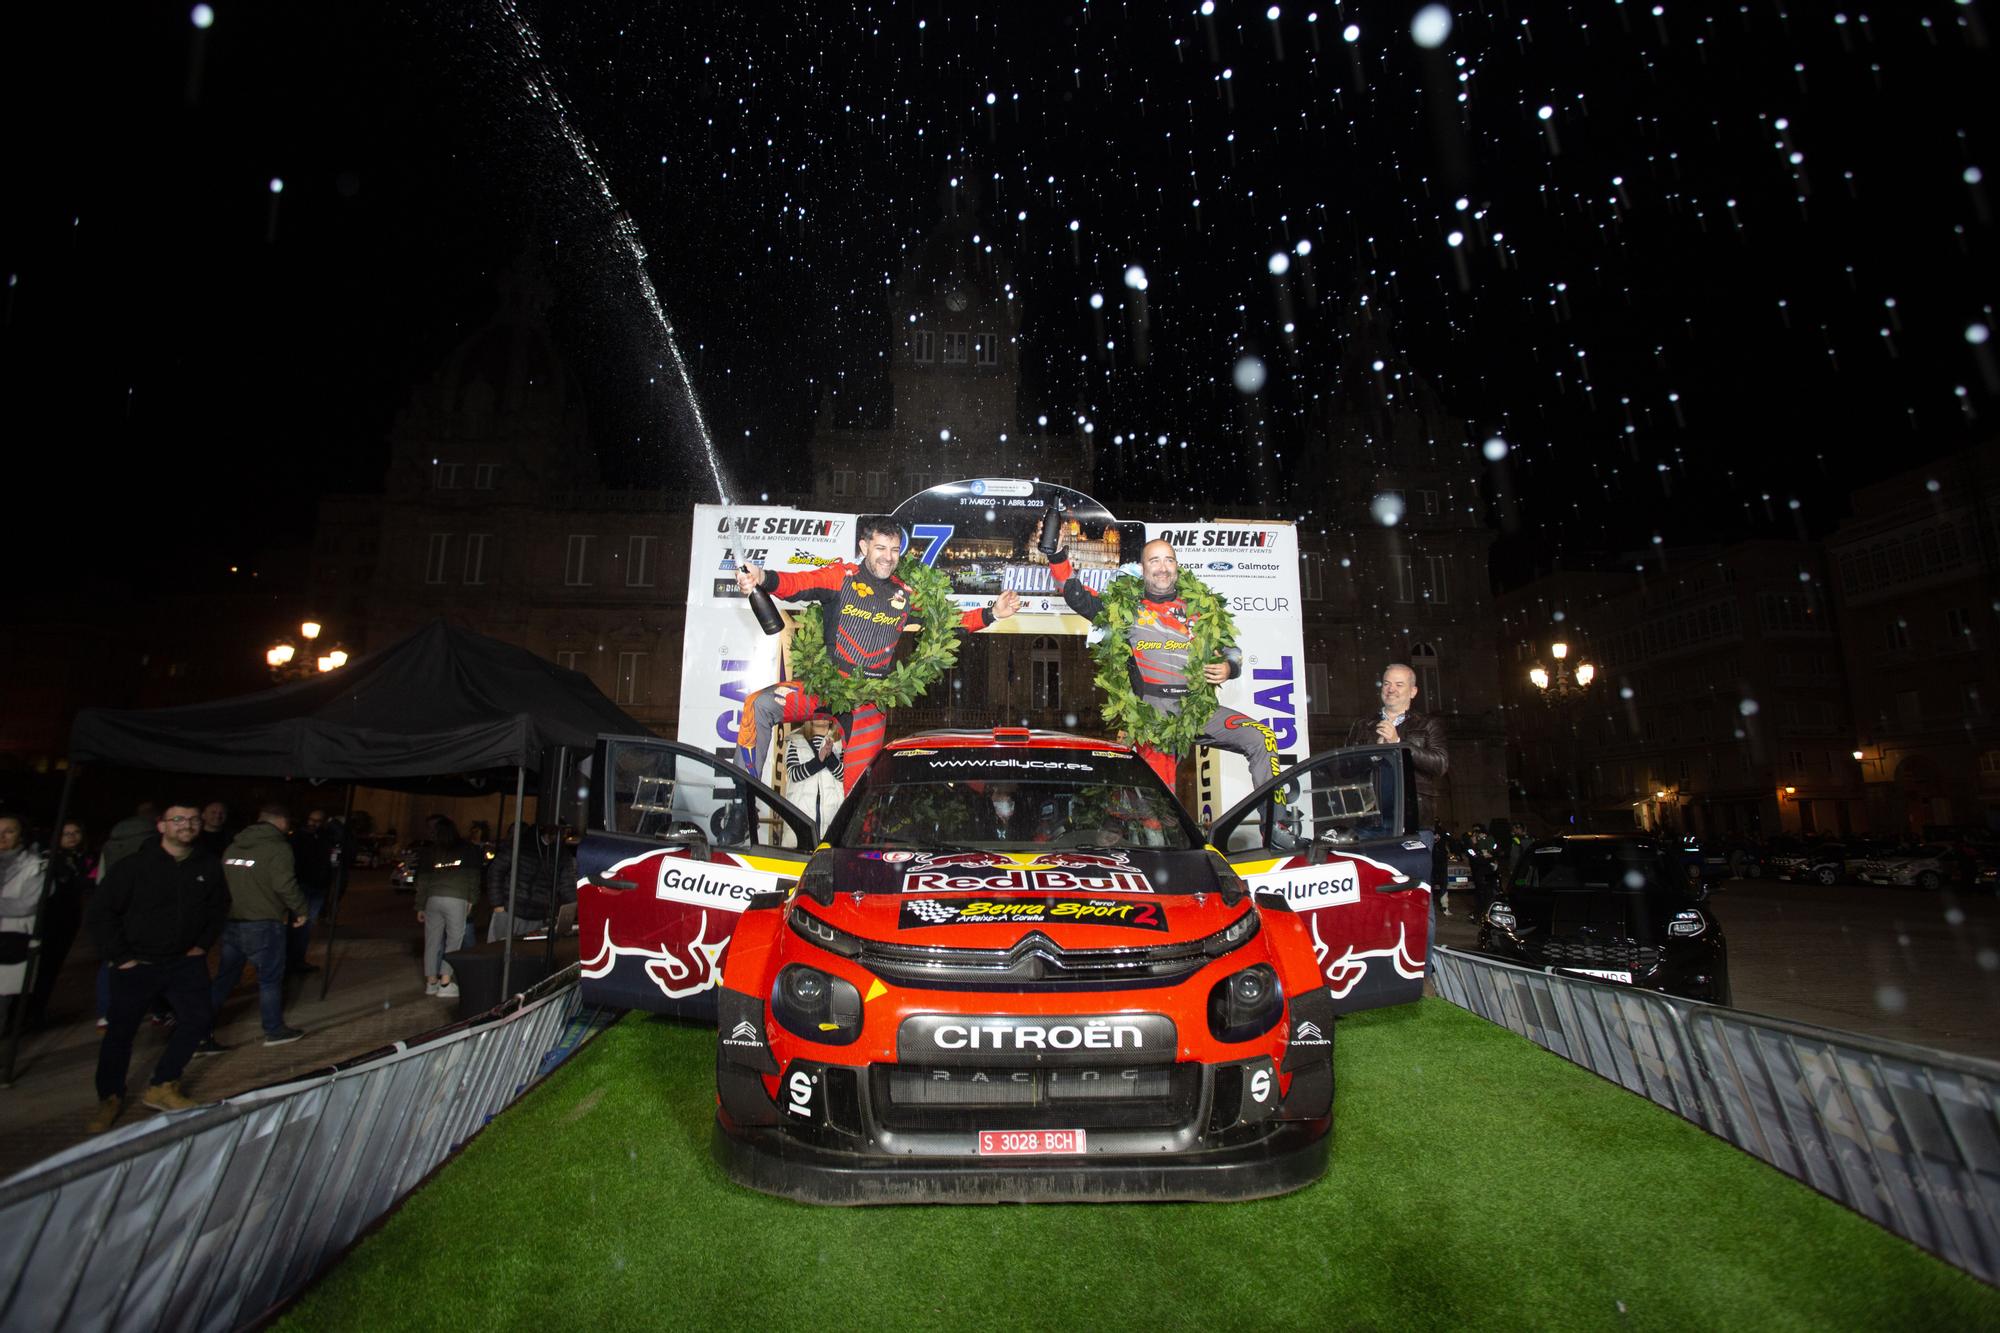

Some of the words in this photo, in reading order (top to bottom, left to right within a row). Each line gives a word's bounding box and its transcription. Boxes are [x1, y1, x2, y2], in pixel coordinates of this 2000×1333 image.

[960, 498, 968, 506] 31
[1008, 499, 1026, 507] ABRIL
[1027, 499, 1044, 507] 2023
[717, 516, 761, 534] ONE
[899, 524, 955, 569] 7
[1160, 529, 1199, 546] ONE
[1178, 562, 1204, 570] zacar
[1237, 562, 1280, 571] Galmotor
[842, 604, 872, 620] Senra
[872, 611, 901, 626] Sport
[1136, 640, 1162, 651] Senra
[1164, 640, 1191, 653] Sport
[929, 758, 1094, 771] www.rallycar.es
[663, 869, 769, 901] Galures
[902, 870, 1029, 892] Red
[1032, 871, 1155, 894] Bull
[960, 902, 1046, 915] Senra
[1050, 903, 1135, 919] Sport
[1134, 903, 1159, 925] 2
[1012, 914, 1045, 922] Coruña
[933, 1020, 1143, 1049] CITROËN
[984, 1135, 993, 1151] S
[1001, 1134, 1038, 1151] 3028
[1045, 1133, 1073, 1149] BCH
